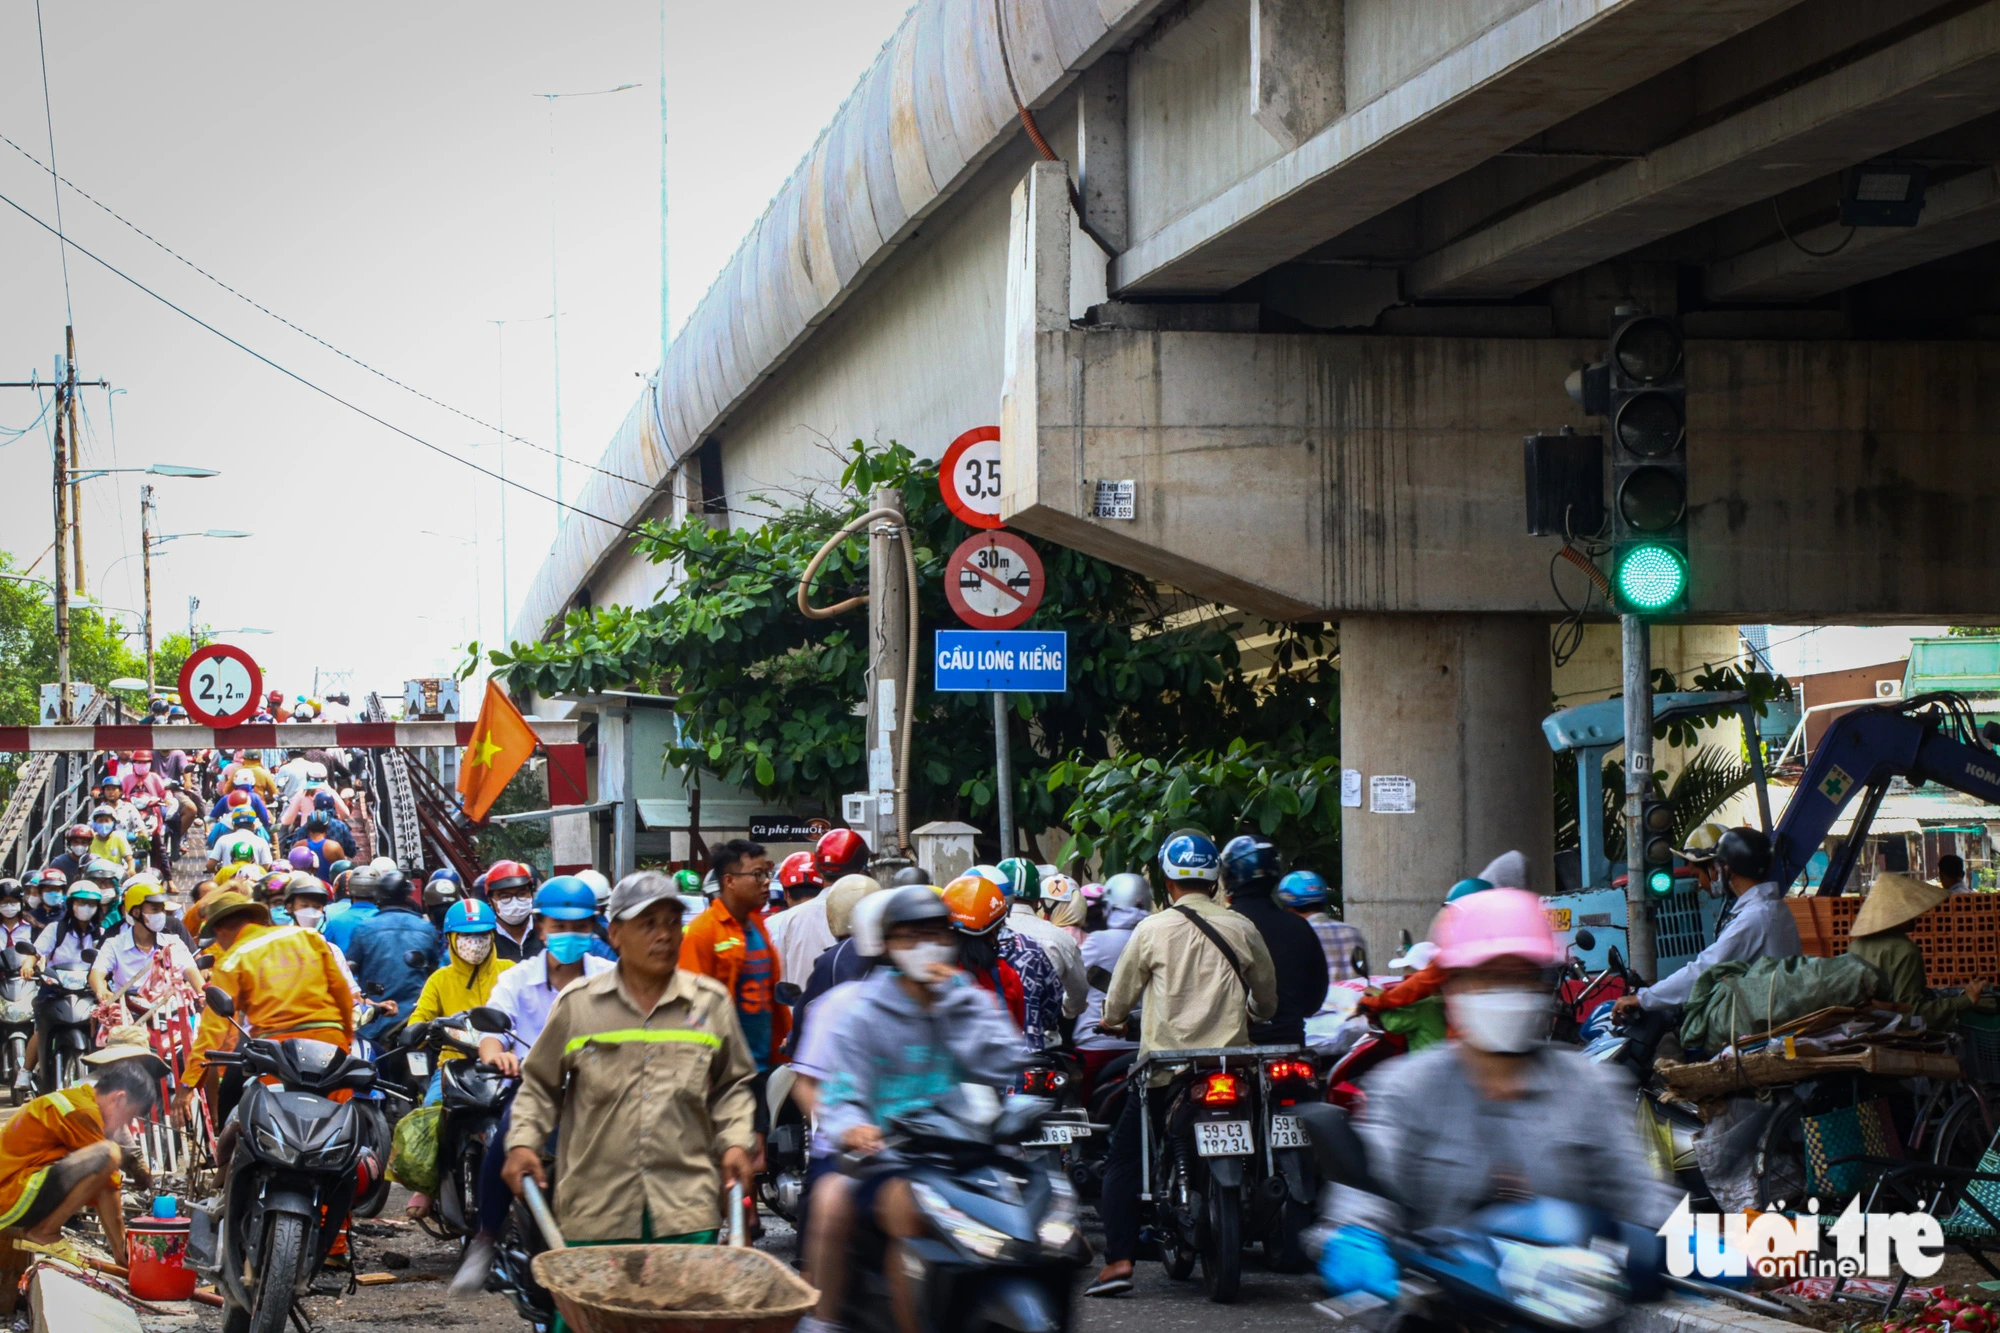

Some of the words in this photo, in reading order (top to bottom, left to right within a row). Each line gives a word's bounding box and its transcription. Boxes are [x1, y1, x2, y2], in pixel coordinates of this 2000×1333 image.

[1119, 507, 1132, 517] 559
[938, 645, 974, 670] CẦU
[978, 650, 1014, 671] LONG
[1019, 644, 1062, 671] KIỂNG
[1635, 755, 1650, 770] 01
[751, 825, 766, 834] Cà
[767, 824, 789, 836] phê
[1203, 1124, 1243, 1139] 59-C3
[1203, 1138, 1250, 1153] 182.34
